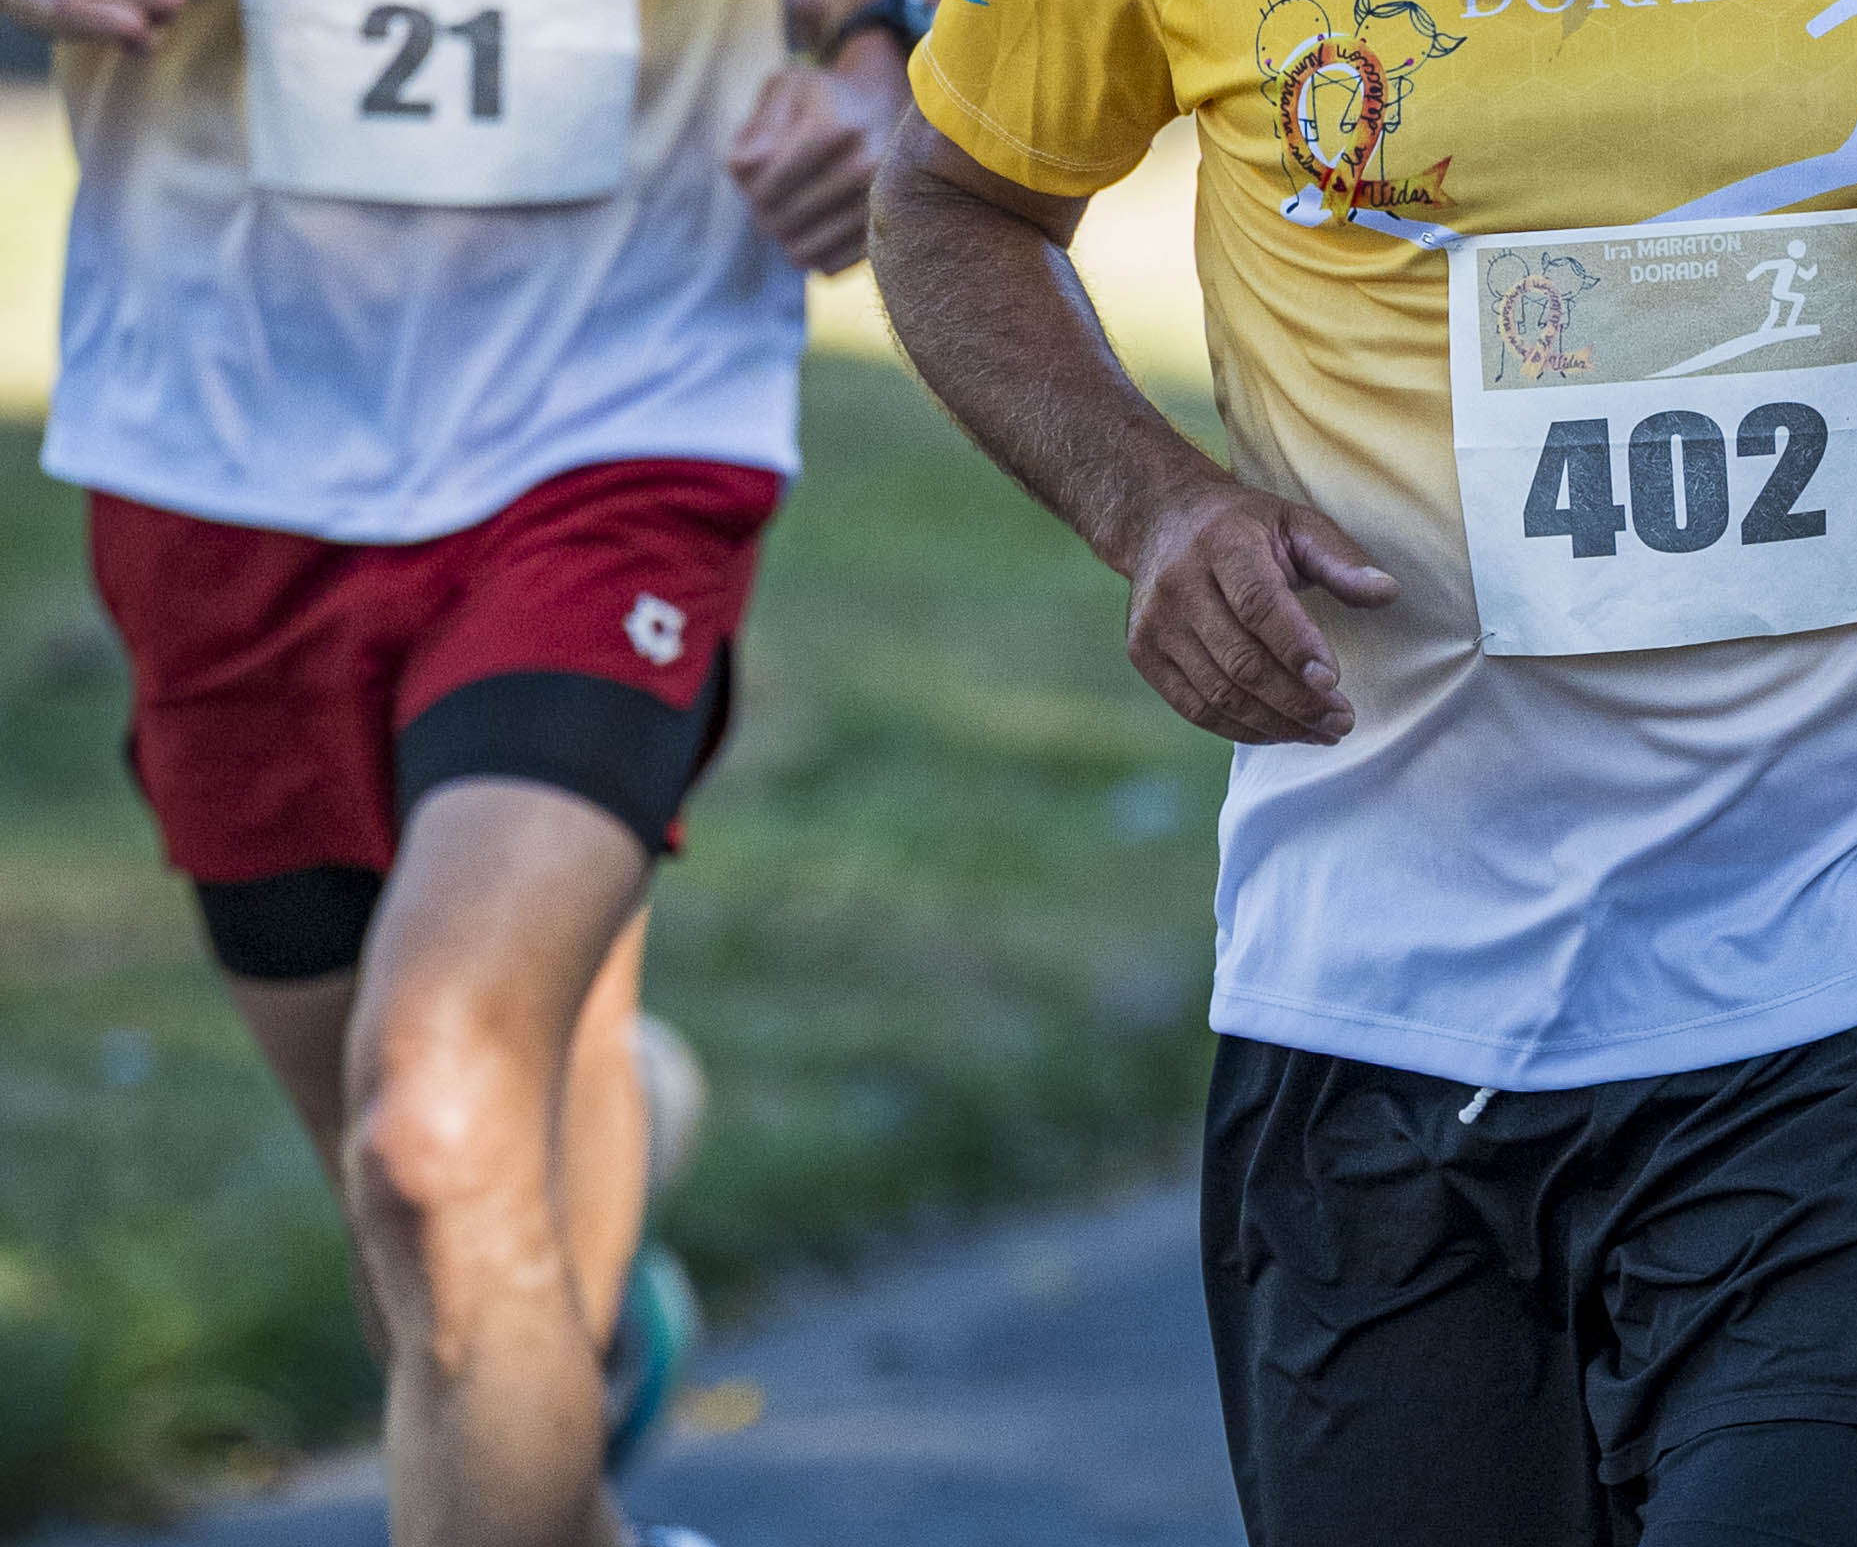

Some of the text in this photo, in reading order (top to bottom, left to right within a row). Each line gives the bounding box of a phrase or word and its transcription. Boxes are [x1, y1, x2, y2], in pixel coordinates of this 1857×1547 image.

[359, 4, 506, 121] 21
[1629, 258, 1720, 285] DORADA
[1522, 401, 1830, 560] 402
